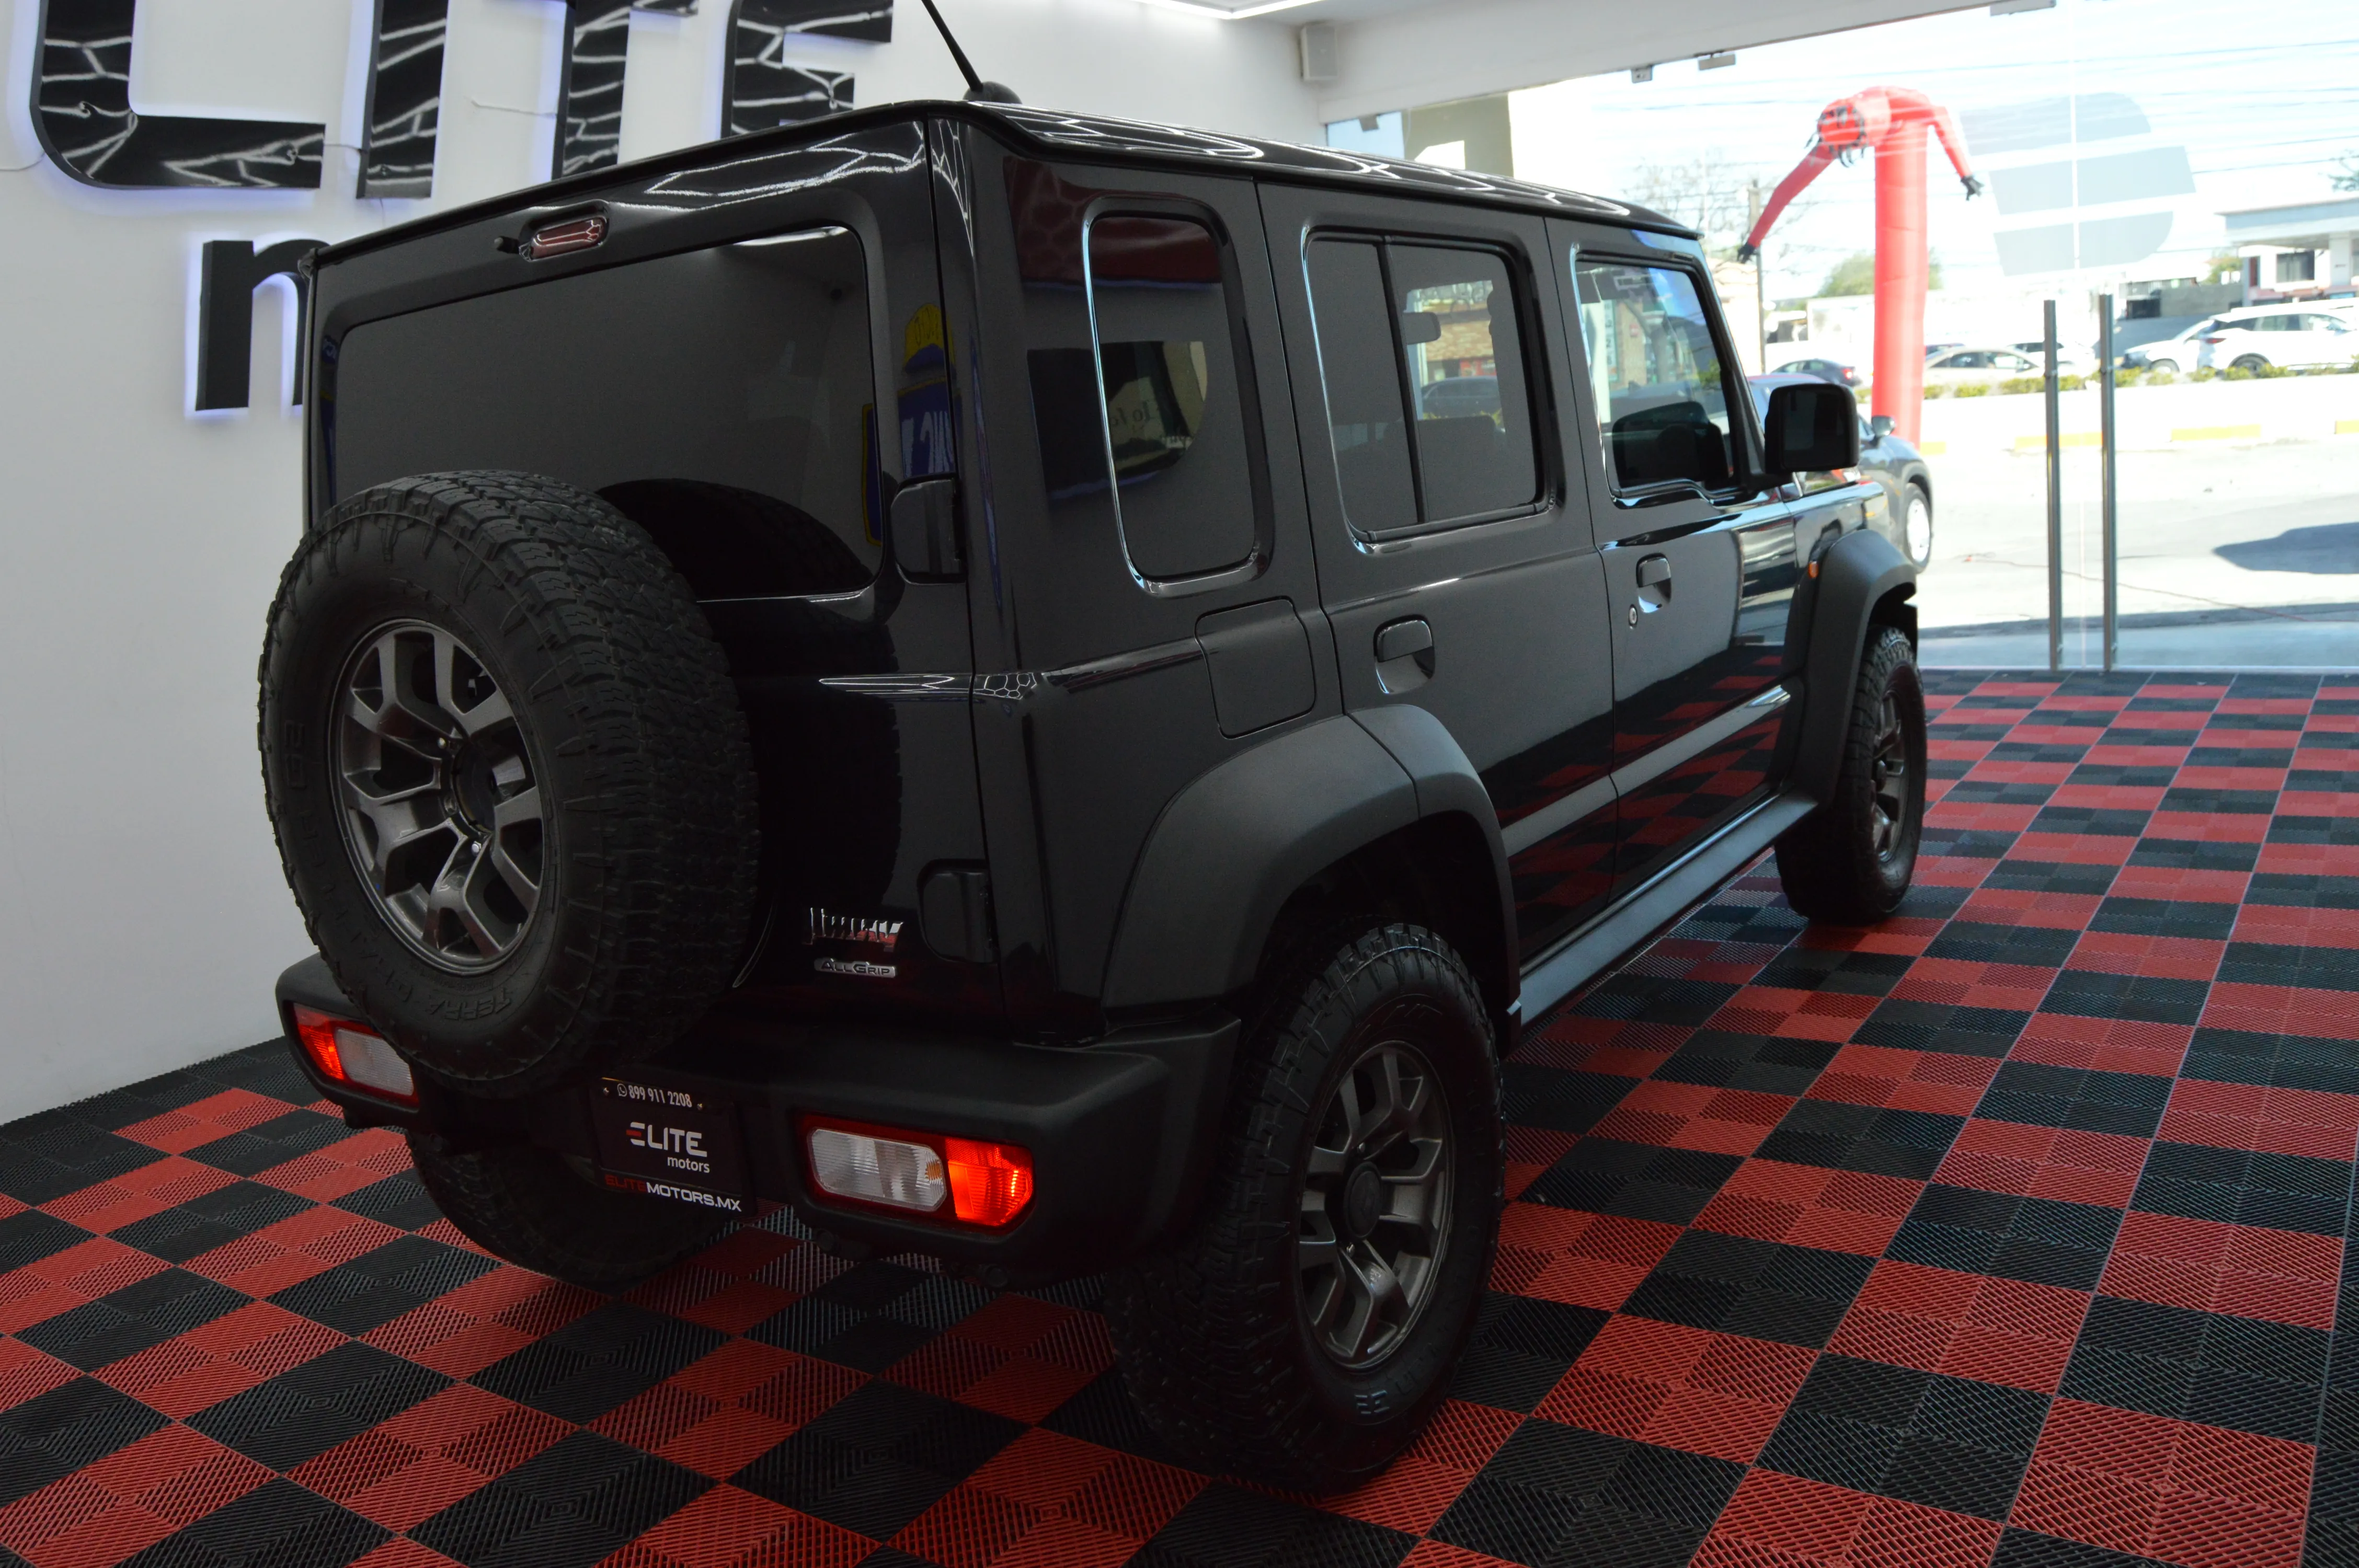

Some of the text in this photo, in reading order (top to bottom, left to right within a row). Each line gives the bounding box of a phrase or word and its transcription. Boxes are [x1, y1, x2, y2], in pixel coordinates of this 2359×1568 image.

[628, 1085, 692, 1108] 899 911 2208
[626, 1122, 707, 1157] ELITE
[667, 1157, 710, 1173] motors
[605, 1175, 741, 1212] ELITEMOTORS.MX
